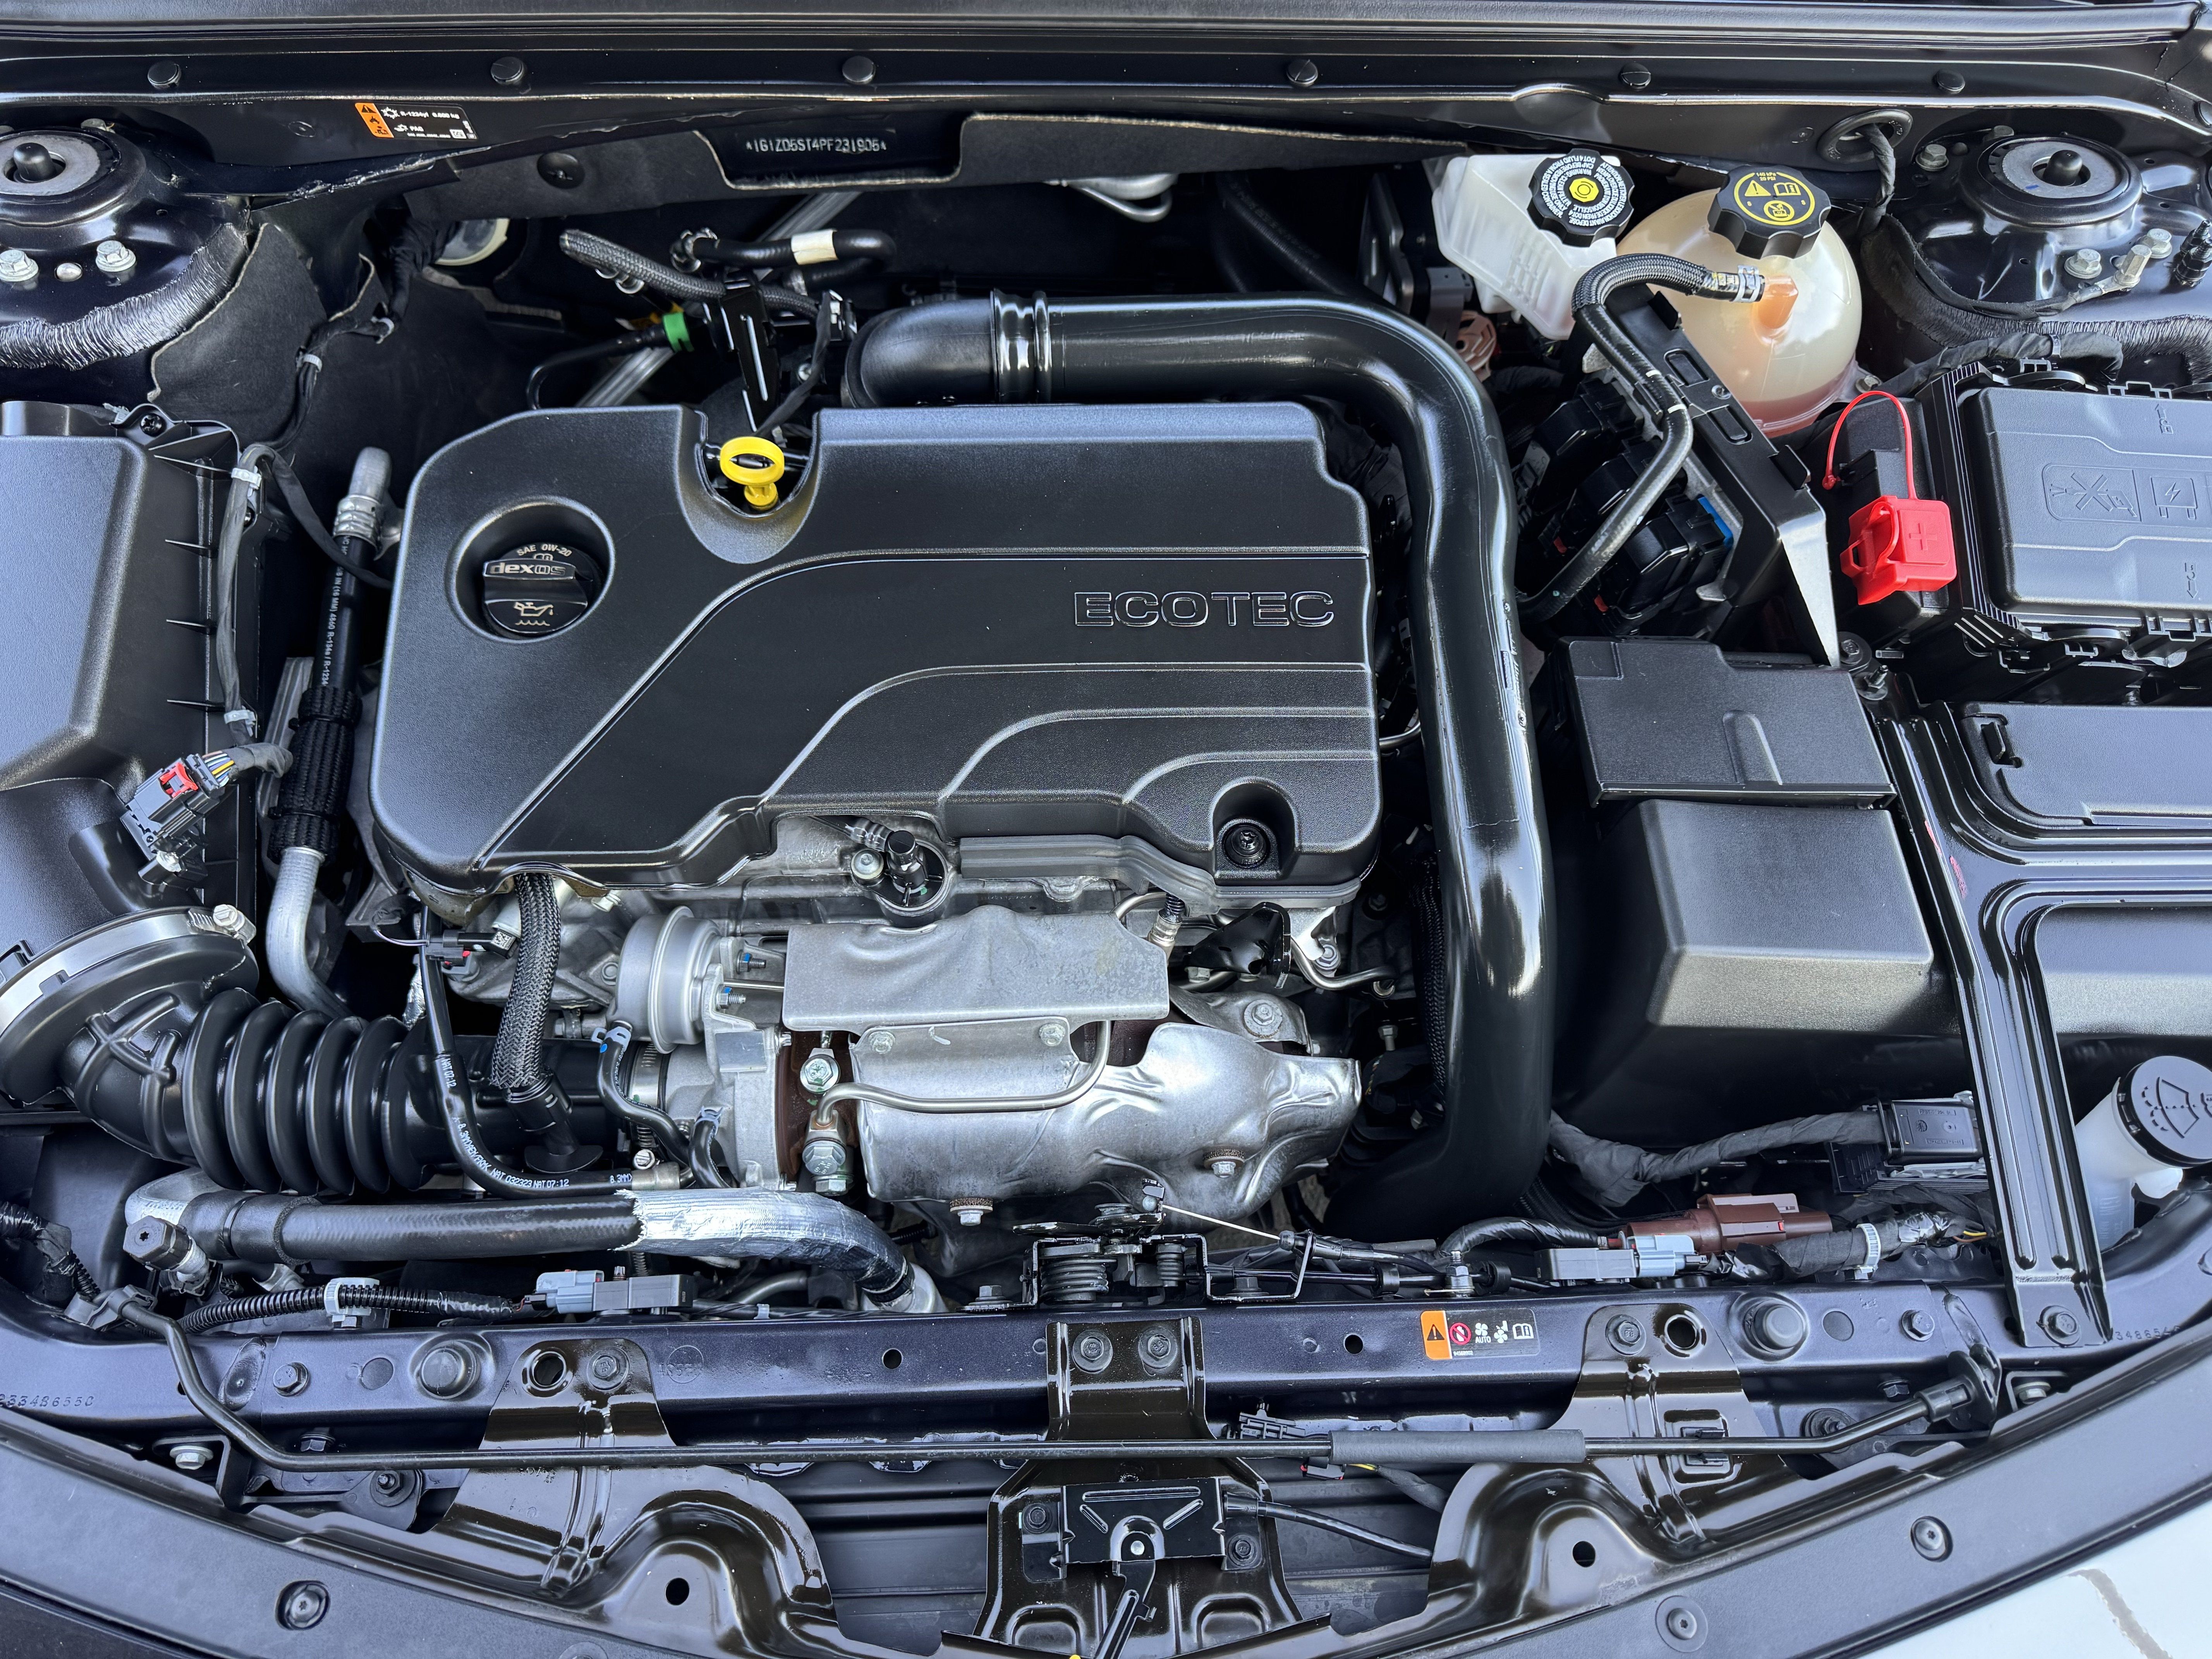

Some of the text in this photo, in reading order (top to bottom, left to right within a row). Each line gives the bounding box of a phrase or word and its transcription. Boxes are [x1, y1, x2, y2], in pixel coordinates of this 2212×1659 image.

[1549, 158, 1564, 172] FROM
[1541, 172, 1551, 191] SEALED
[1557, 176, 1568, 191] CLEAN
[518, 544, 572, 557] SAE 0W-20
[489, 562, 566, 575] dexos
[1074, 591, 1334, 627] ECOTEC
[444, 1070, 457, 1088] 07:12
[489, 1168, 506, 1180] NAT
[505, 1175, 532, 1187] 032323
[547, 1179, 569, 1188] 07:12
